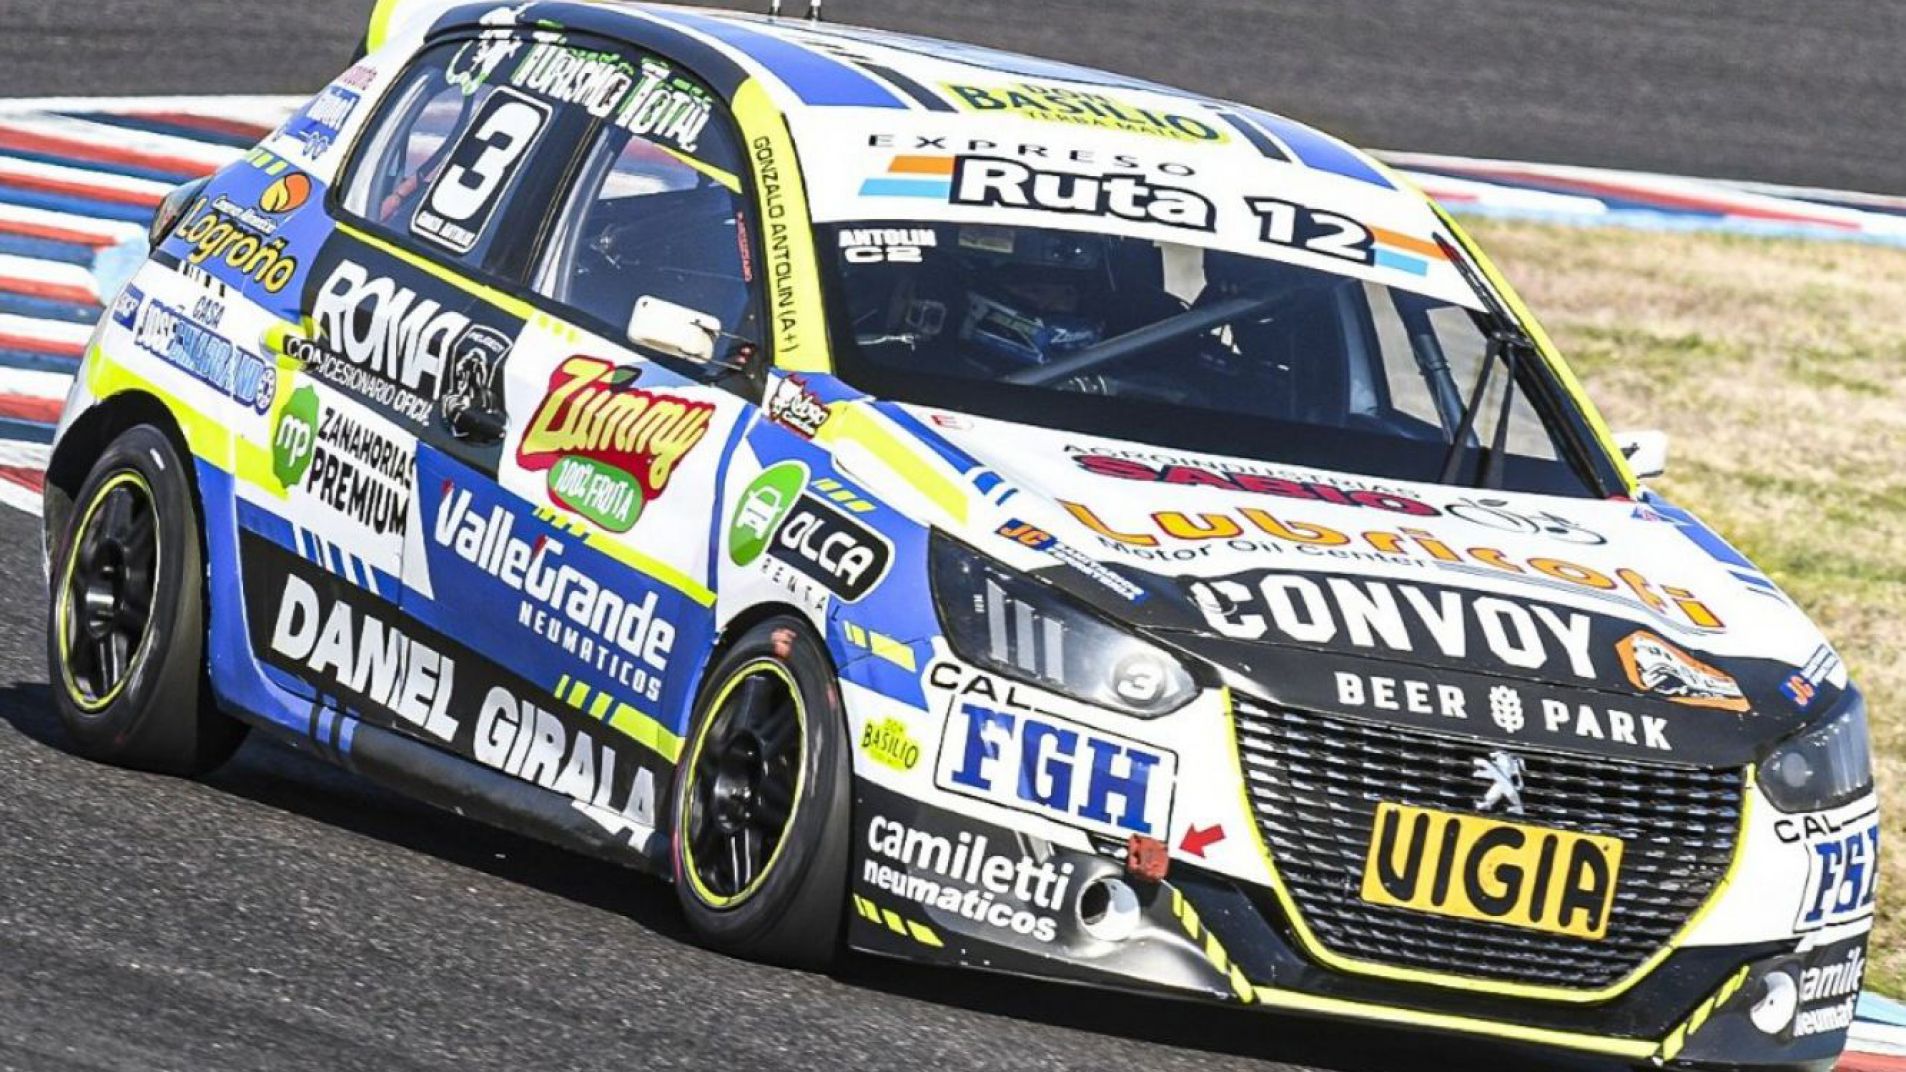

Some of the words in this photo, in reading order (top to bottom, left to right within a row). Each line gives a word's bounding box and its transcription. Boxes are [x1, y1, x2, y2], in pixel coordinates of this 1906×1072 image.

[510, 30, 633, 118] TURISMO
[615, 58, 711, 152] TOTAL
[951, 84, 1219, 140] BASILIO
[430, 102, 542, 220] 3
[868, 134, 1196, 177] EXPRESO
[175, 196, 297, 293] Logroño
[753, 135, 786, 219] GONZALO
[771, 223, 793, 308] ANTOLIN
[838, 228, 938, 247] ANTOLIN
[951, 154, 1218, 233] Ruta
[1244, 196, 1376, 266] 12
[844, 246, 923, 263] C2
[312, 258, 471, 400] ROMA
[276, 414, 310, 467] mp
[317, 405, 417, 491] ZANAHORIAS
[1063, 443, 1421, 499] AGROINDUSTRIAS
[306, 446, 410, 538] PREMIUM
[556, 459, 595, 498] 100%
[582, 472, 635, 522] FRUTA
[1071, 454, 1441, 517] SABIO
[434, 480, 676, 672] ValleGrande
[1097, 535, 1212, 561] Motor
[1227, 539, 1285, 554] Oil
[518, 600, 662, 702] NEUMATICOS
[1190, 571, 1597, 680] CONVOY
[270, 573, 459, 743] DANIEL
[472, 685, 657, 853] GIRALA
[929, 662, 1032, 710] CAL
[1335, 671, 1468, 719] BEER
[1543, 700, 1673, 751] PARK
[861, 722, 920, 770] BASILIO
[951, 702, 1162, 834] FGH
[868, 814, 1075, 912] camiletti
[1773, 813, 1842, 844] CAL
[863, 858, 1058, 942] neumaticos
